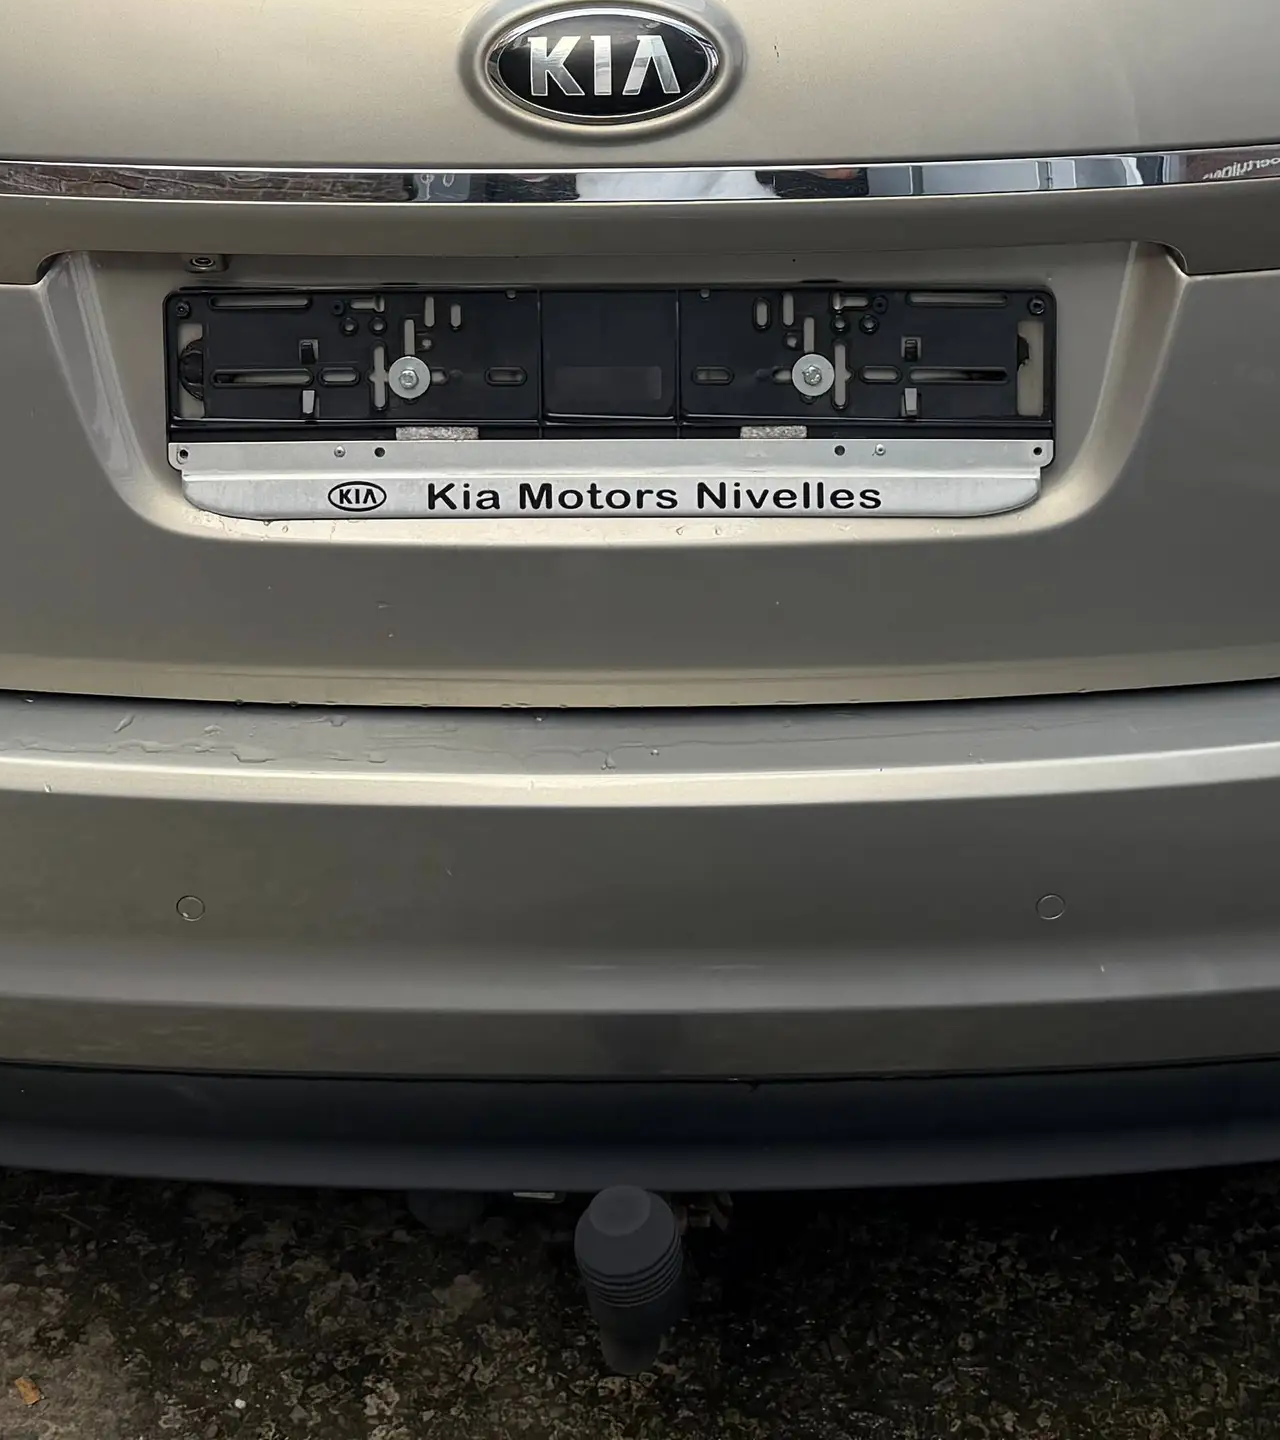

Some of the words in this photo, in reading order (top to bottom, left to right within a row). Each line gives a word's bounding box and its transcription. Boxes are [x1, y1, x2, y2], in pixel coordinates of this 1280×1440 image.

[527, 34, 681, 97] KIA
[426, 482, 500, 511] Kia
[518, 482, 677, 511] Motors
[696, 482, 882, 511] Nivelles
